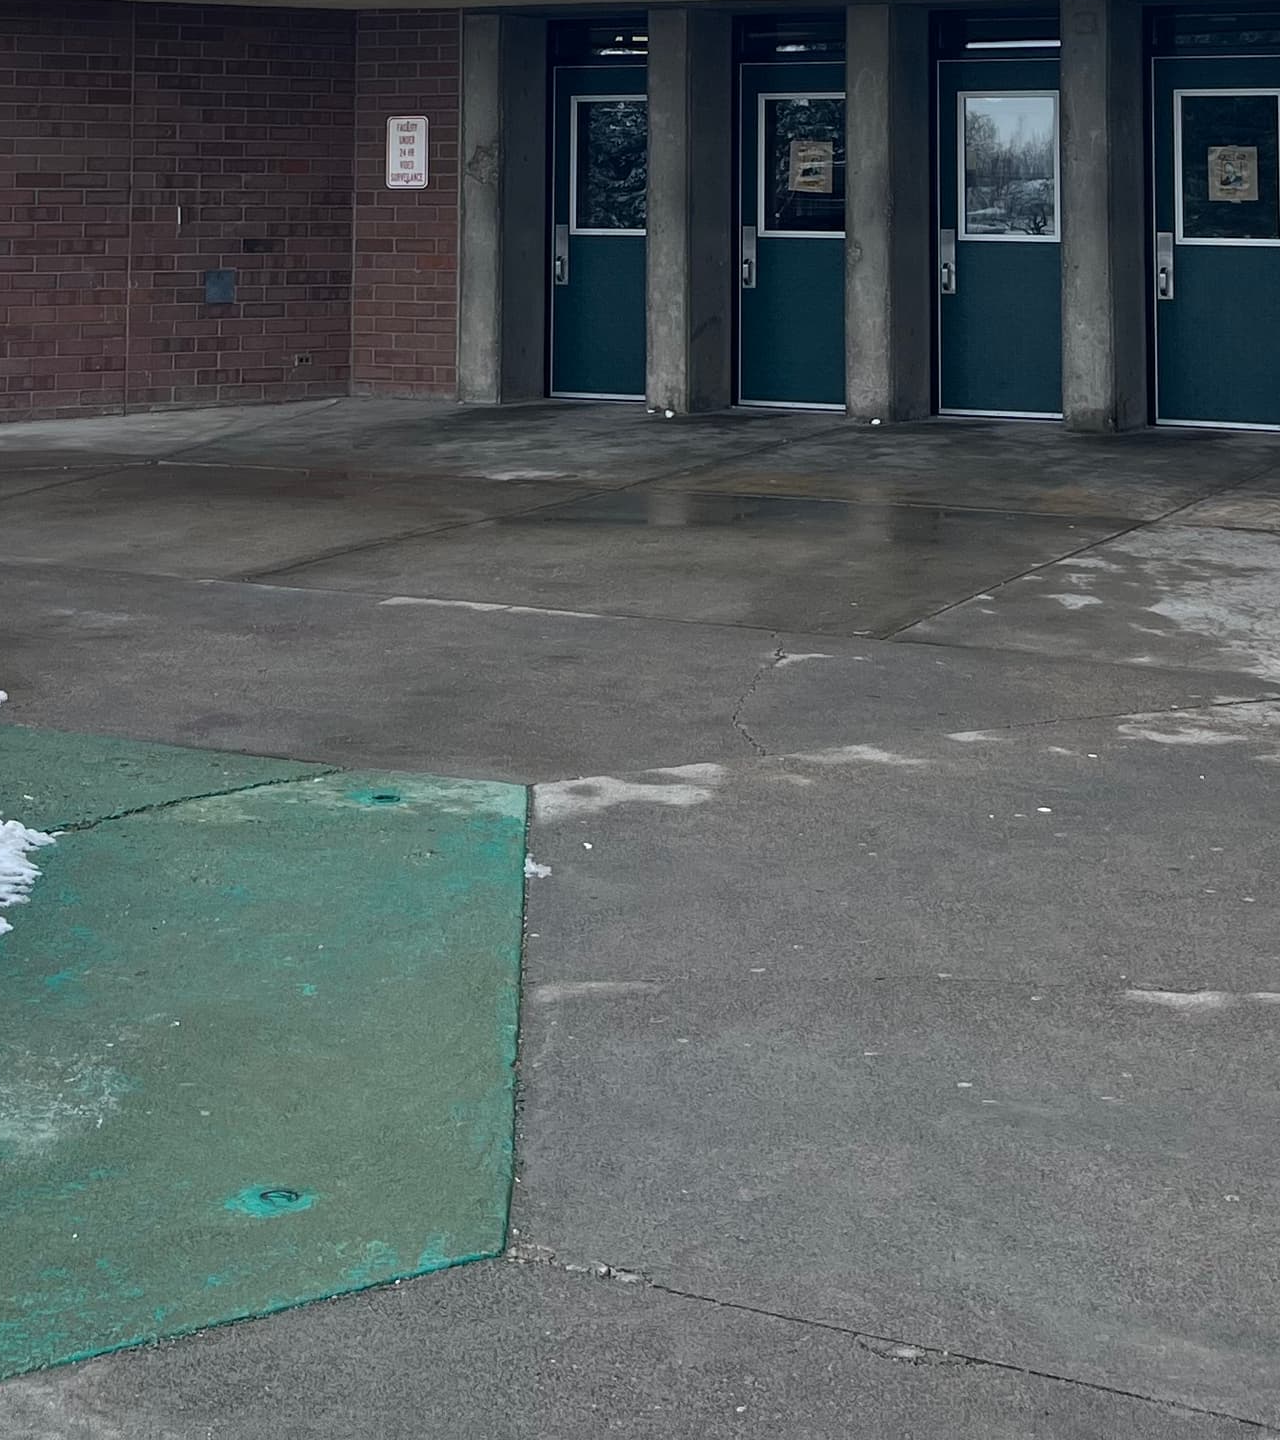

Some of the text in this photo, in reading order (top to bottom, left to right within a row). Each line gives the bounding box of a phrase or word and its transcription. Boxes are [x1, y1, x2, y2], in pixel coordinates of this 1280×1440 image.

[399, 136, 415, 144] UNDER
[399, 148, 415, 157] 24 HR
[400, 160, 414, 169] VIDEO
